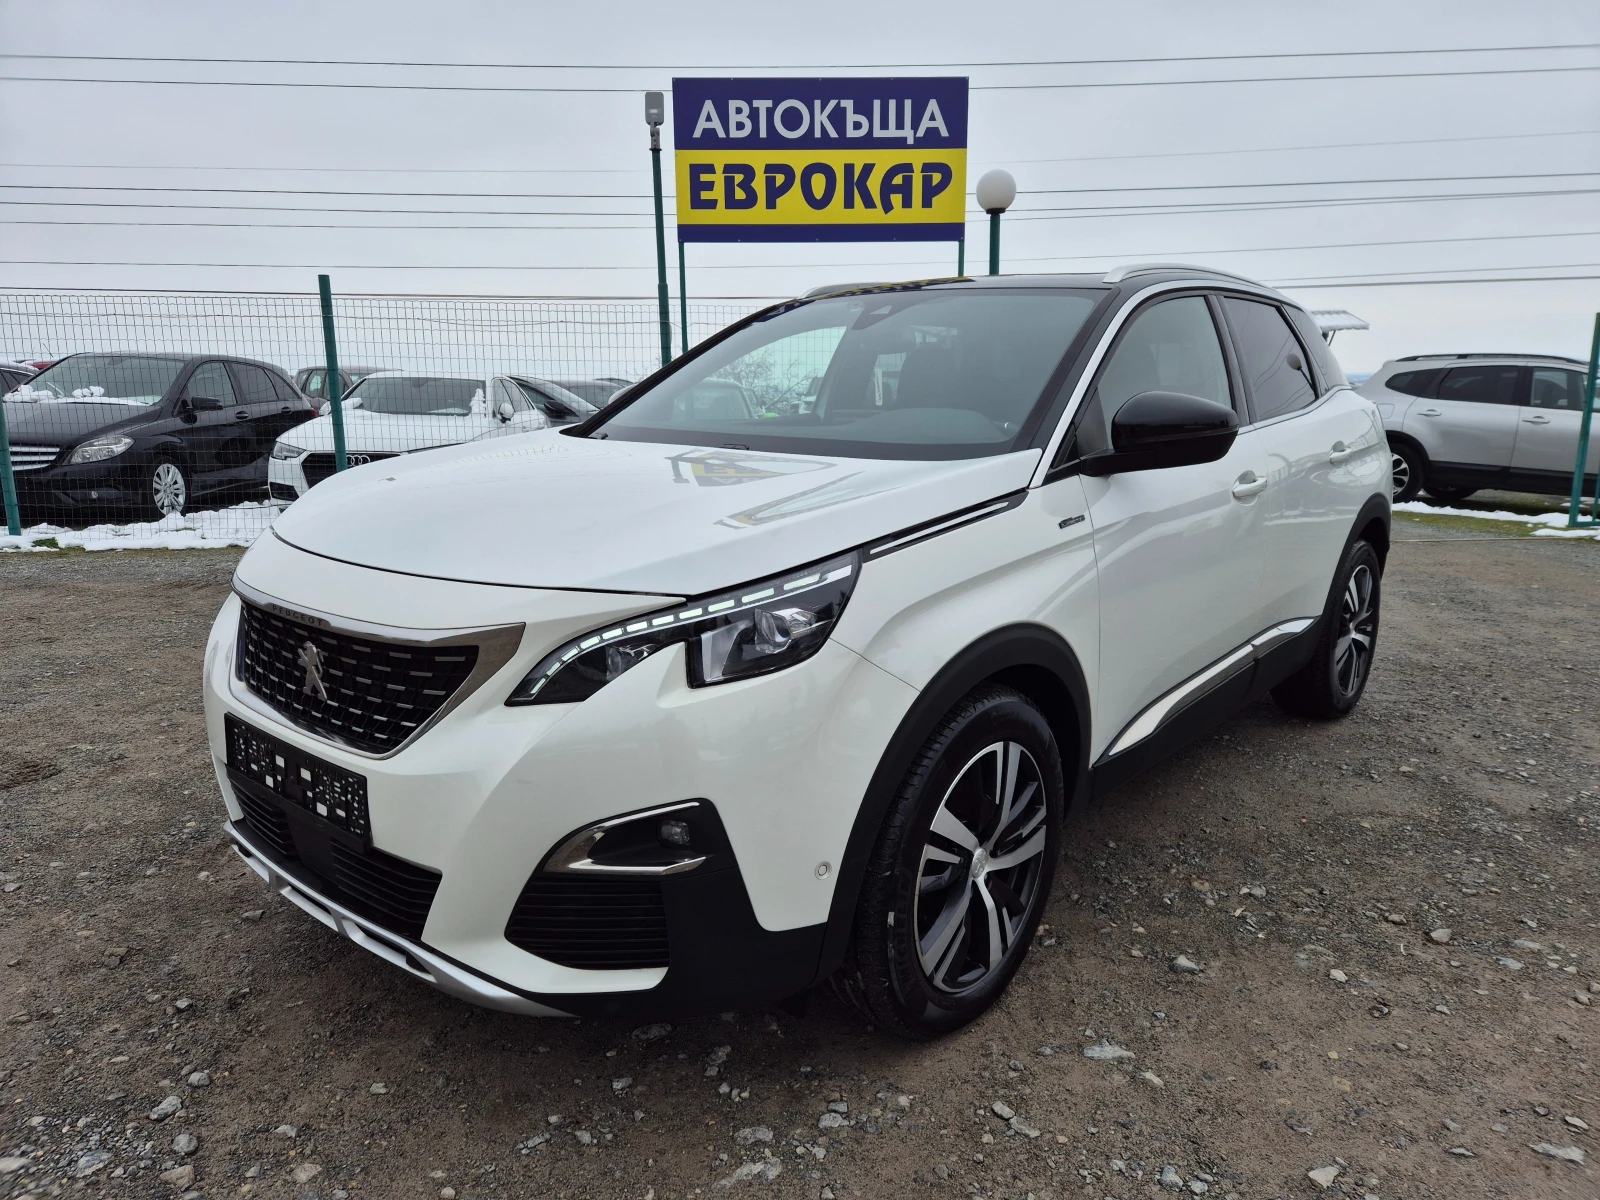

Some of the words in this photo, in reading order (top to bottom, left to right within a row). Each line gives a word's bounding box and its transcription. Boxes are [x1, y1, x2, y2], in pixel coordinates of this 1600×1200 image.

[692, 98, 949, 144] АВТОКЪЩА
[689, 162, 953, 215] ЕВРОКАР
[271, 604, 323, 627] PEUGEOT
